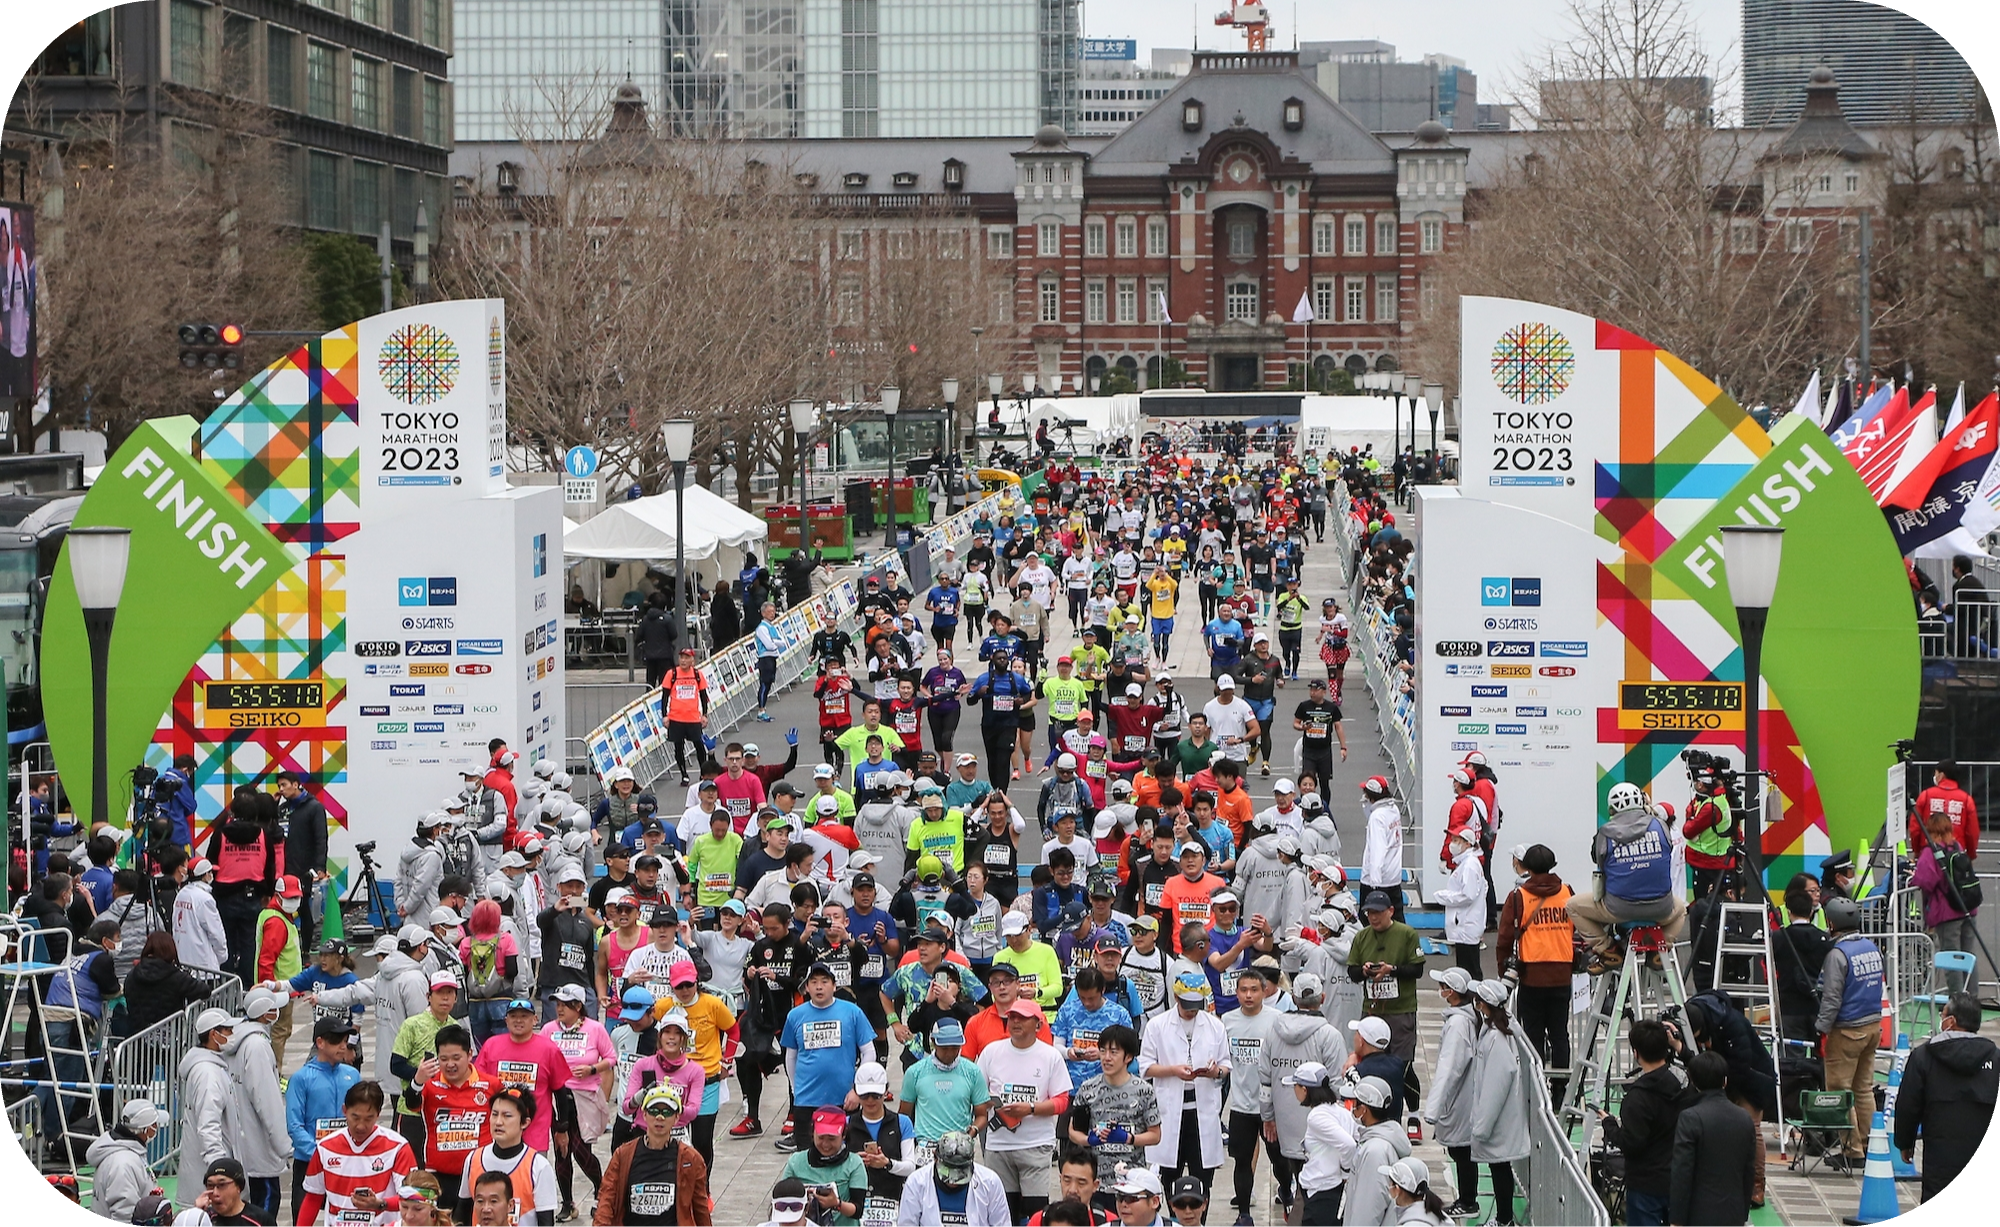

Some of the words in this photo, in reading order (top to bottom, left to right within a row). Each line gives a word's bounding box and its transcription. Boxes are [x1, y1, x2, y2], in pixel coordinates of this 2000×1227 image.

[1085, 42, 1126, 52] 近畿大学
[381, 412, 459, 430] TOKYO
[1492, 412, 1573, 429] TOKYO
[382, 434, 458, 444] MARATHON
[1494, 434, 1572, 444] MARATHON
[381, 448, 460, 470] 2023
[1492, 448, 1573, 471] 2023
[122, 446, 267, 590] FINISH
[1683, 443, 1833, 589] FIISH
[360, 642, 396, 650] TOKIO
[420, 643, 447, 653] asics
[1506, 645, 1530, 654] asics
[410, 666, 448, 674] SEIKO
[1492, 667, 1530, 675] SEIKO
[230, 686, 320, 706] 5:55:10
[1645, 687, 1738, 708] 5:55:10
[1517, 708, 1544, 716] Salonpas
[230, 712, 301, 727] SEIKO
[1643, 714, 1721, 729] SEIKO
[1930, 798, 1964, 813] 医師
[1613, 842, 1662, 858] CAMERA
[1534, 906, 1568, 925] OFFICIA
[1070, 947, 1096, 958] KANA
[1070, 959, 1097, 968] ZAWA
[811, 1031, 832, 1040] 26917
[1272, 1058, 1304, 1068] OFFICI
[505, 1073, 528, 1082] 29086
[1100, 1092, 1128, 1106] TOKYO
[445, 1132, 469, 1141] 21047
[639, 1196, 664, 1205] 26770
[867, 1210, 891, 1219] 55693
